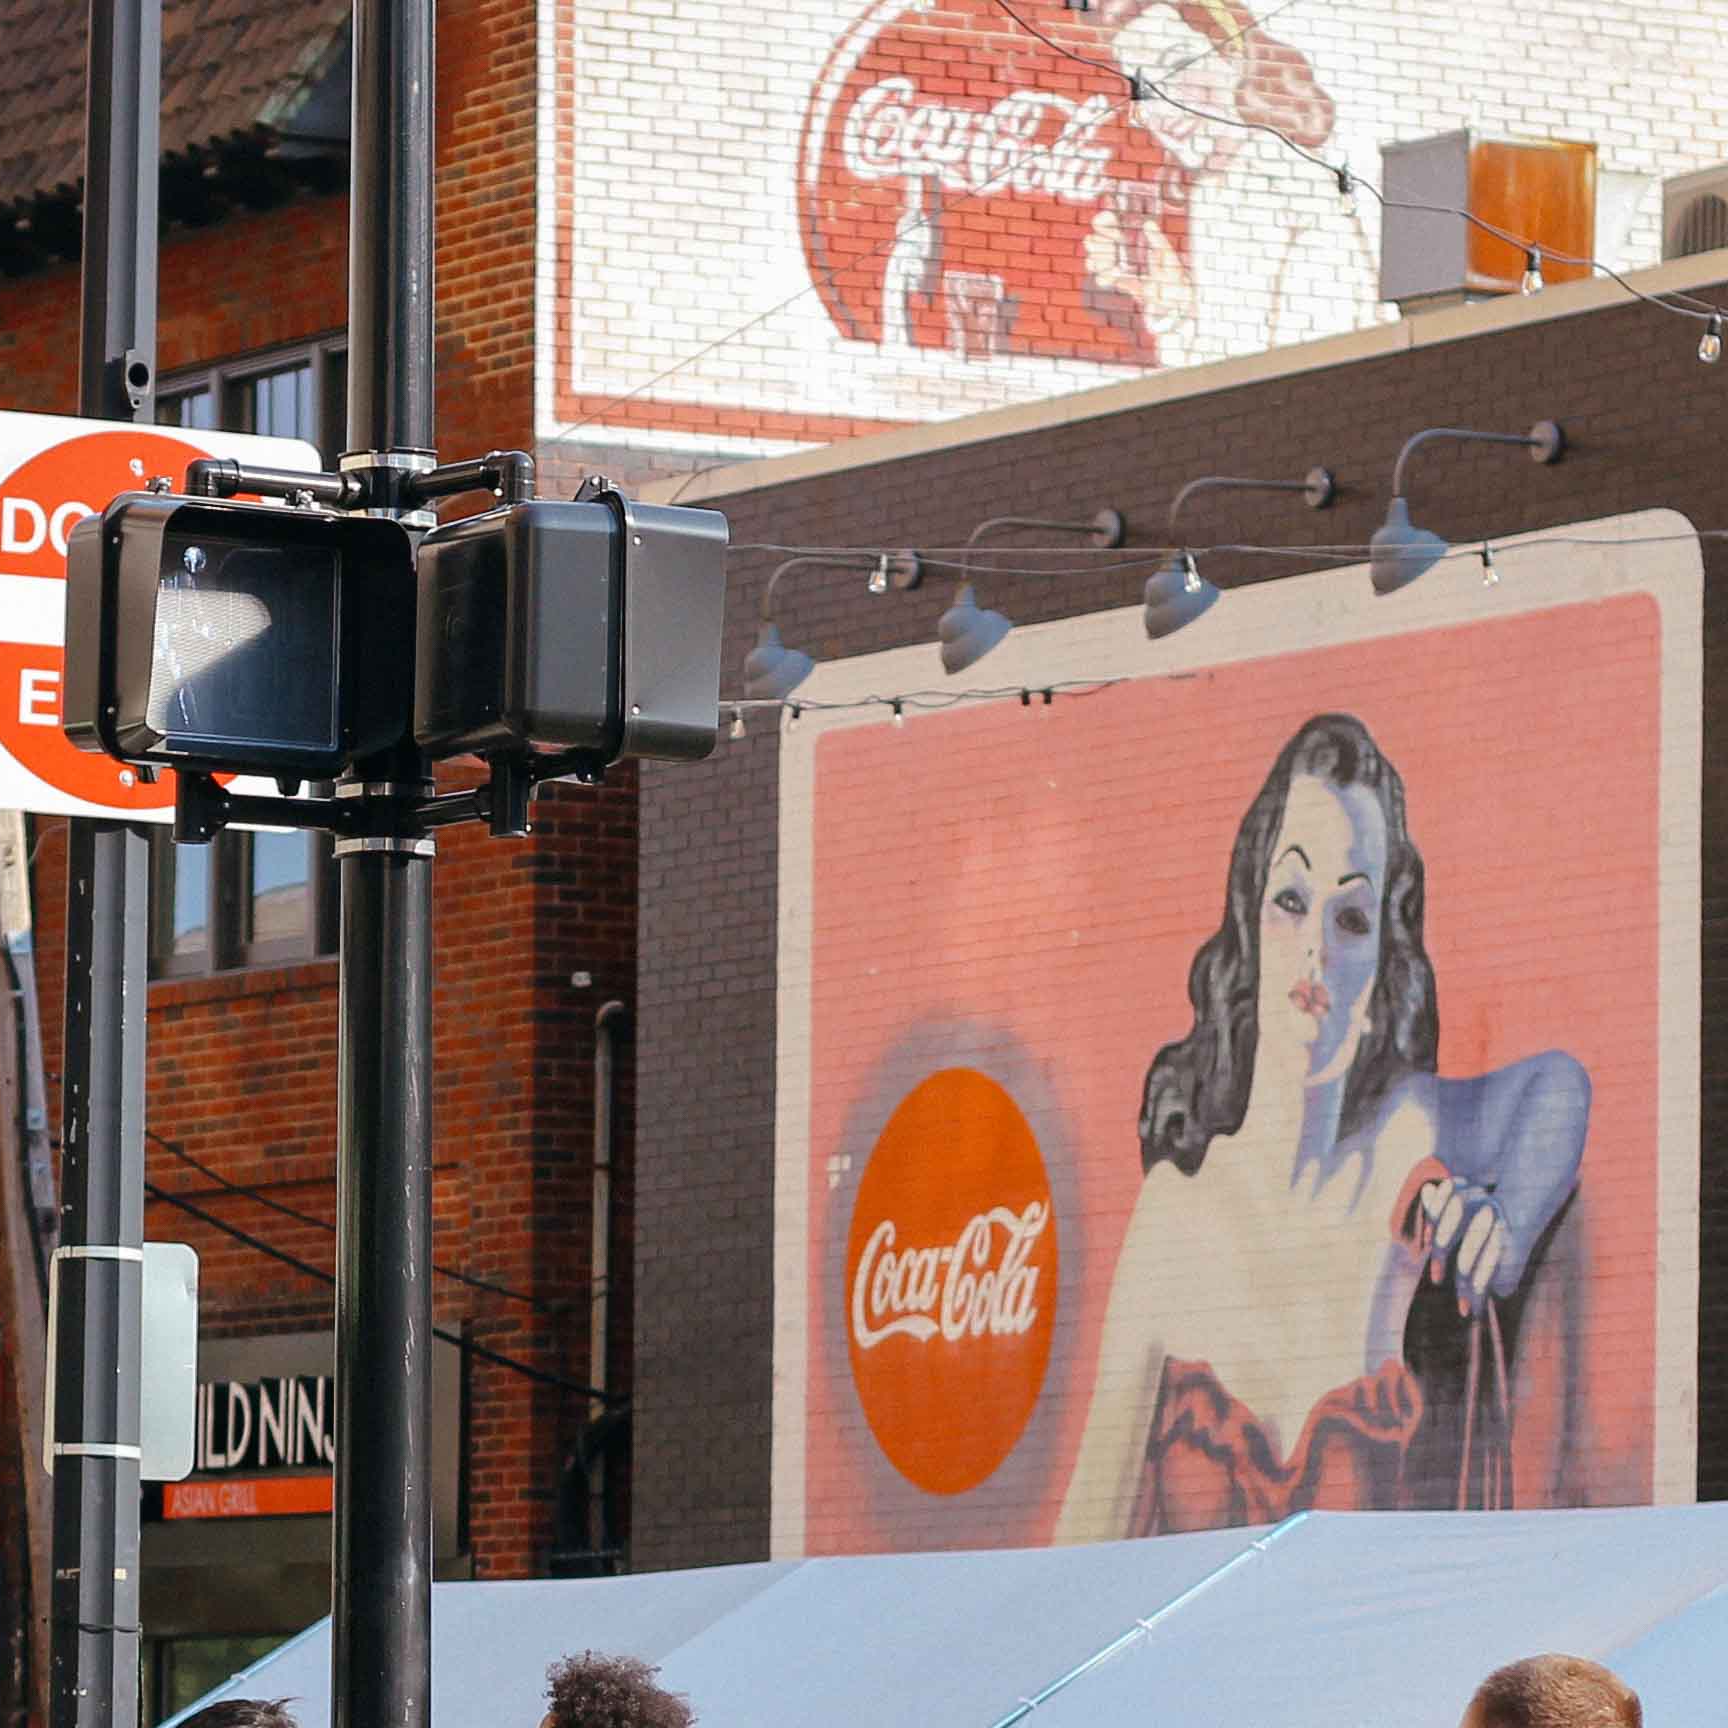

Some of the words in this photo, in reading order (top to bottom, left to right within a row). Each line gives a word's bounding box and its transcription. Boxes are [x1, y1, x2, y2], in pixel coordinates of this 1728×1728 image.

[843, 76, 1113, 199] Coca-Cola
[852, 1200, 1049, 1349] Coca-Cola
[197, 1380, 252, 1469] ILD
